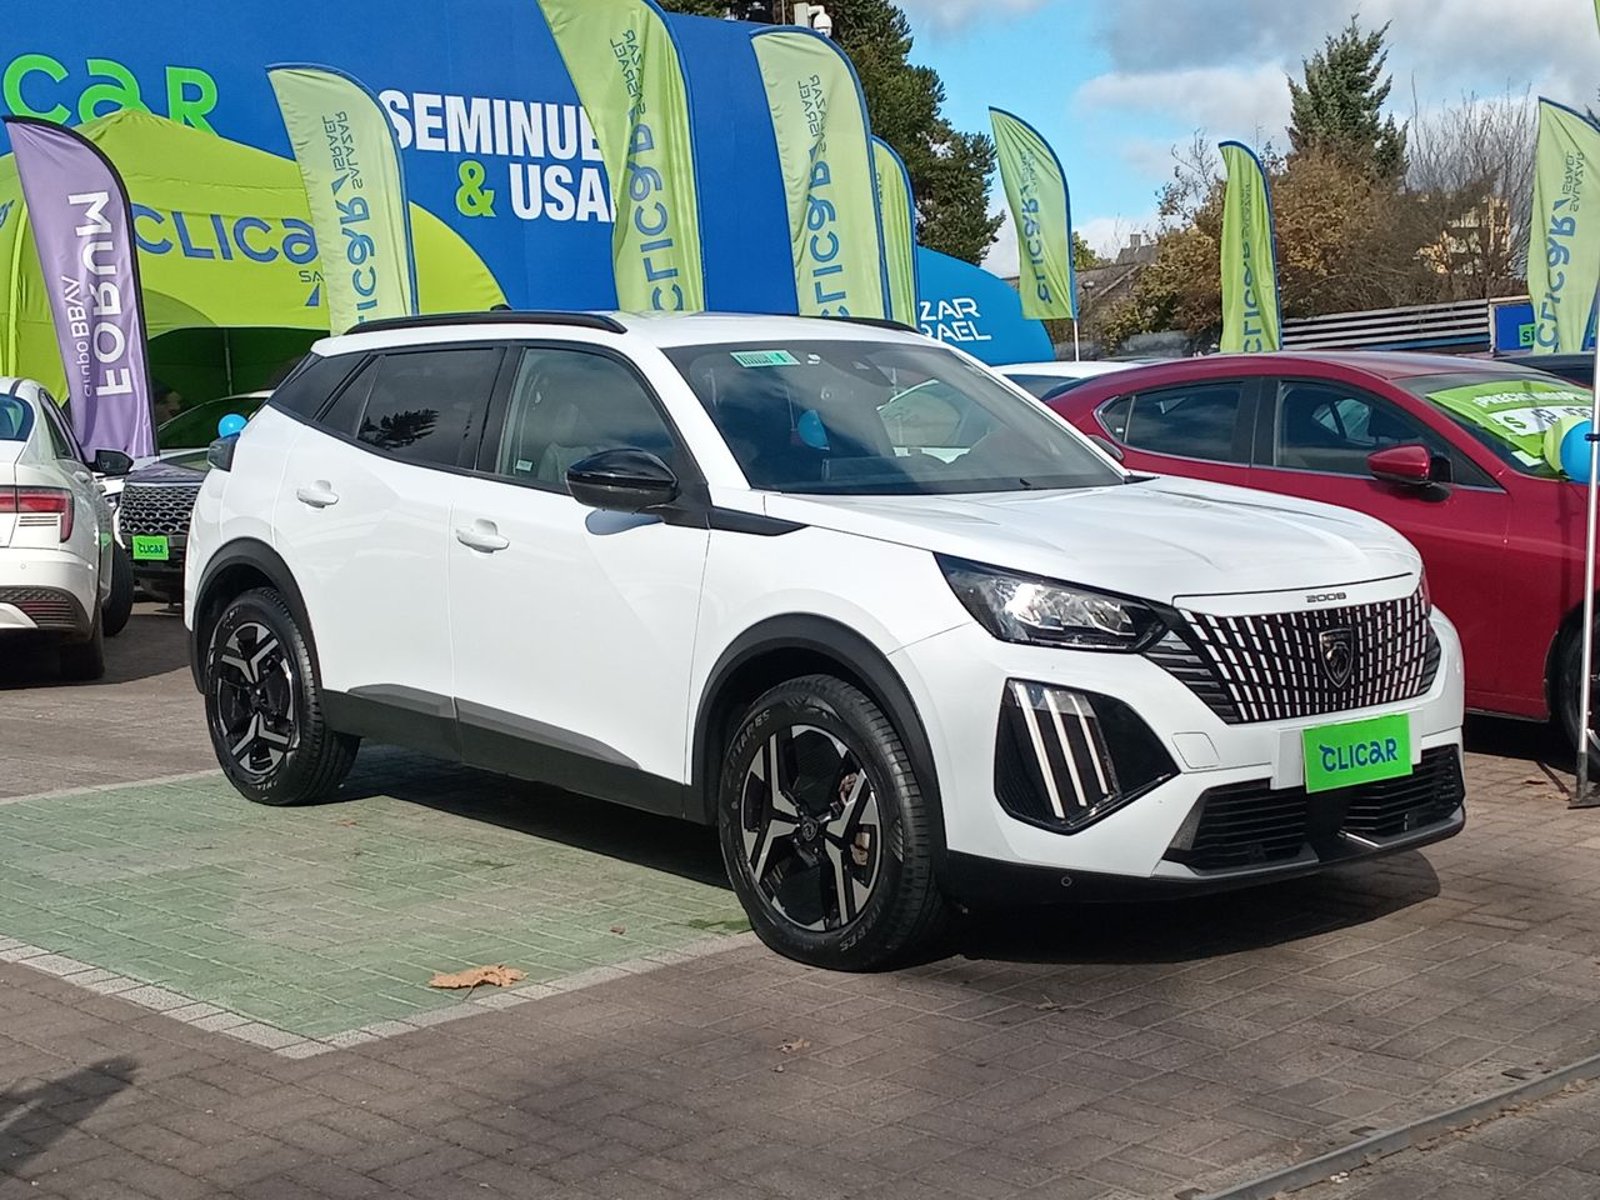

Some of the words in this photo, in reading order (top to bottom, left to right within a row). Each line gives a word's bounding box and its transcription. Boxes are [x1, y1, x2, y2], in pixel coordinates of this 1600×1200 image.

[455, 160, 496, 217] &
[509, 163, 617, 222] USA
[919, 297, 981, 321] ZAR
[1305, 592, 1347, 603] 2008
